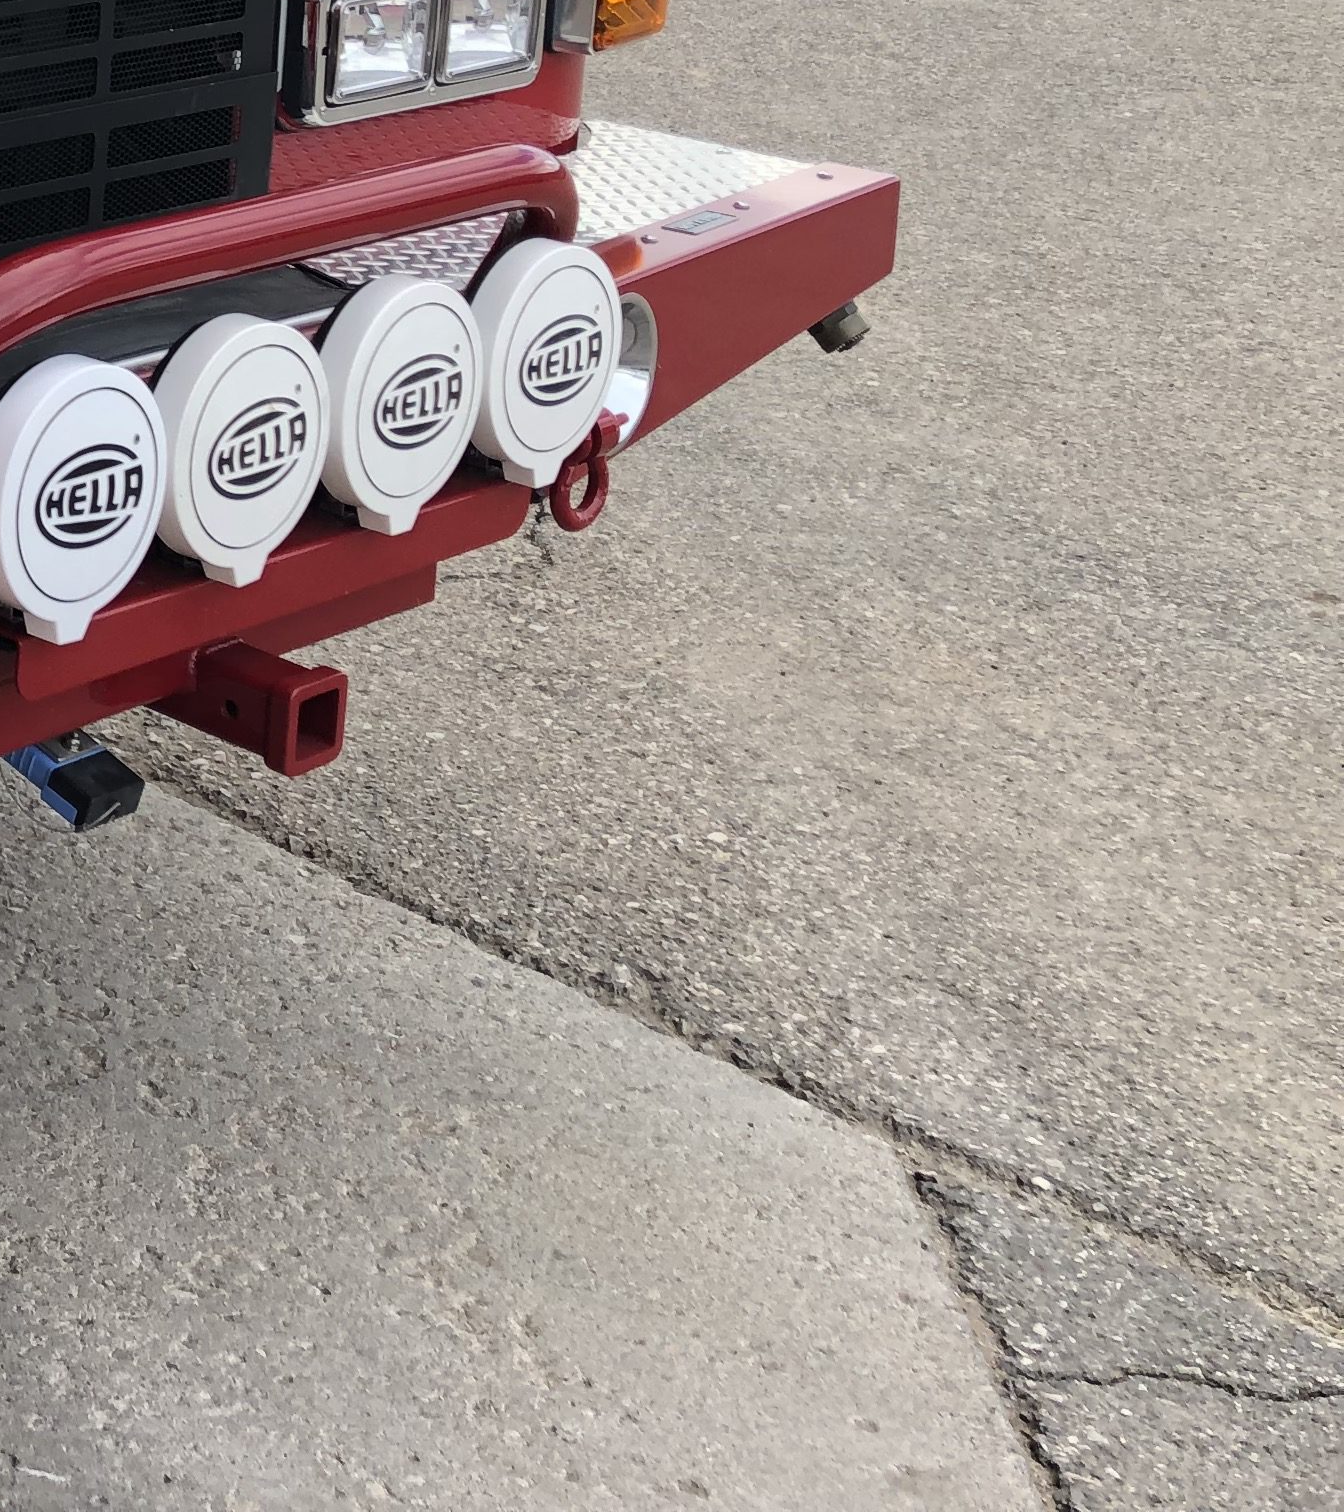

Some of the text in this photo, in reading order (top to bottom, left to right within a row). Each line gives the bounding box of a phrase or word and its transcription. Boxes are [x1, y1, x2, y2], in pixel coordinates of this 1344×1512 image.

[526, 330, 603, 383] HELLA
[381, 370, 462, 424] HELLA
[217, 411, 307, 476] HELLA
[45, 464, 143, 518] HELLA
